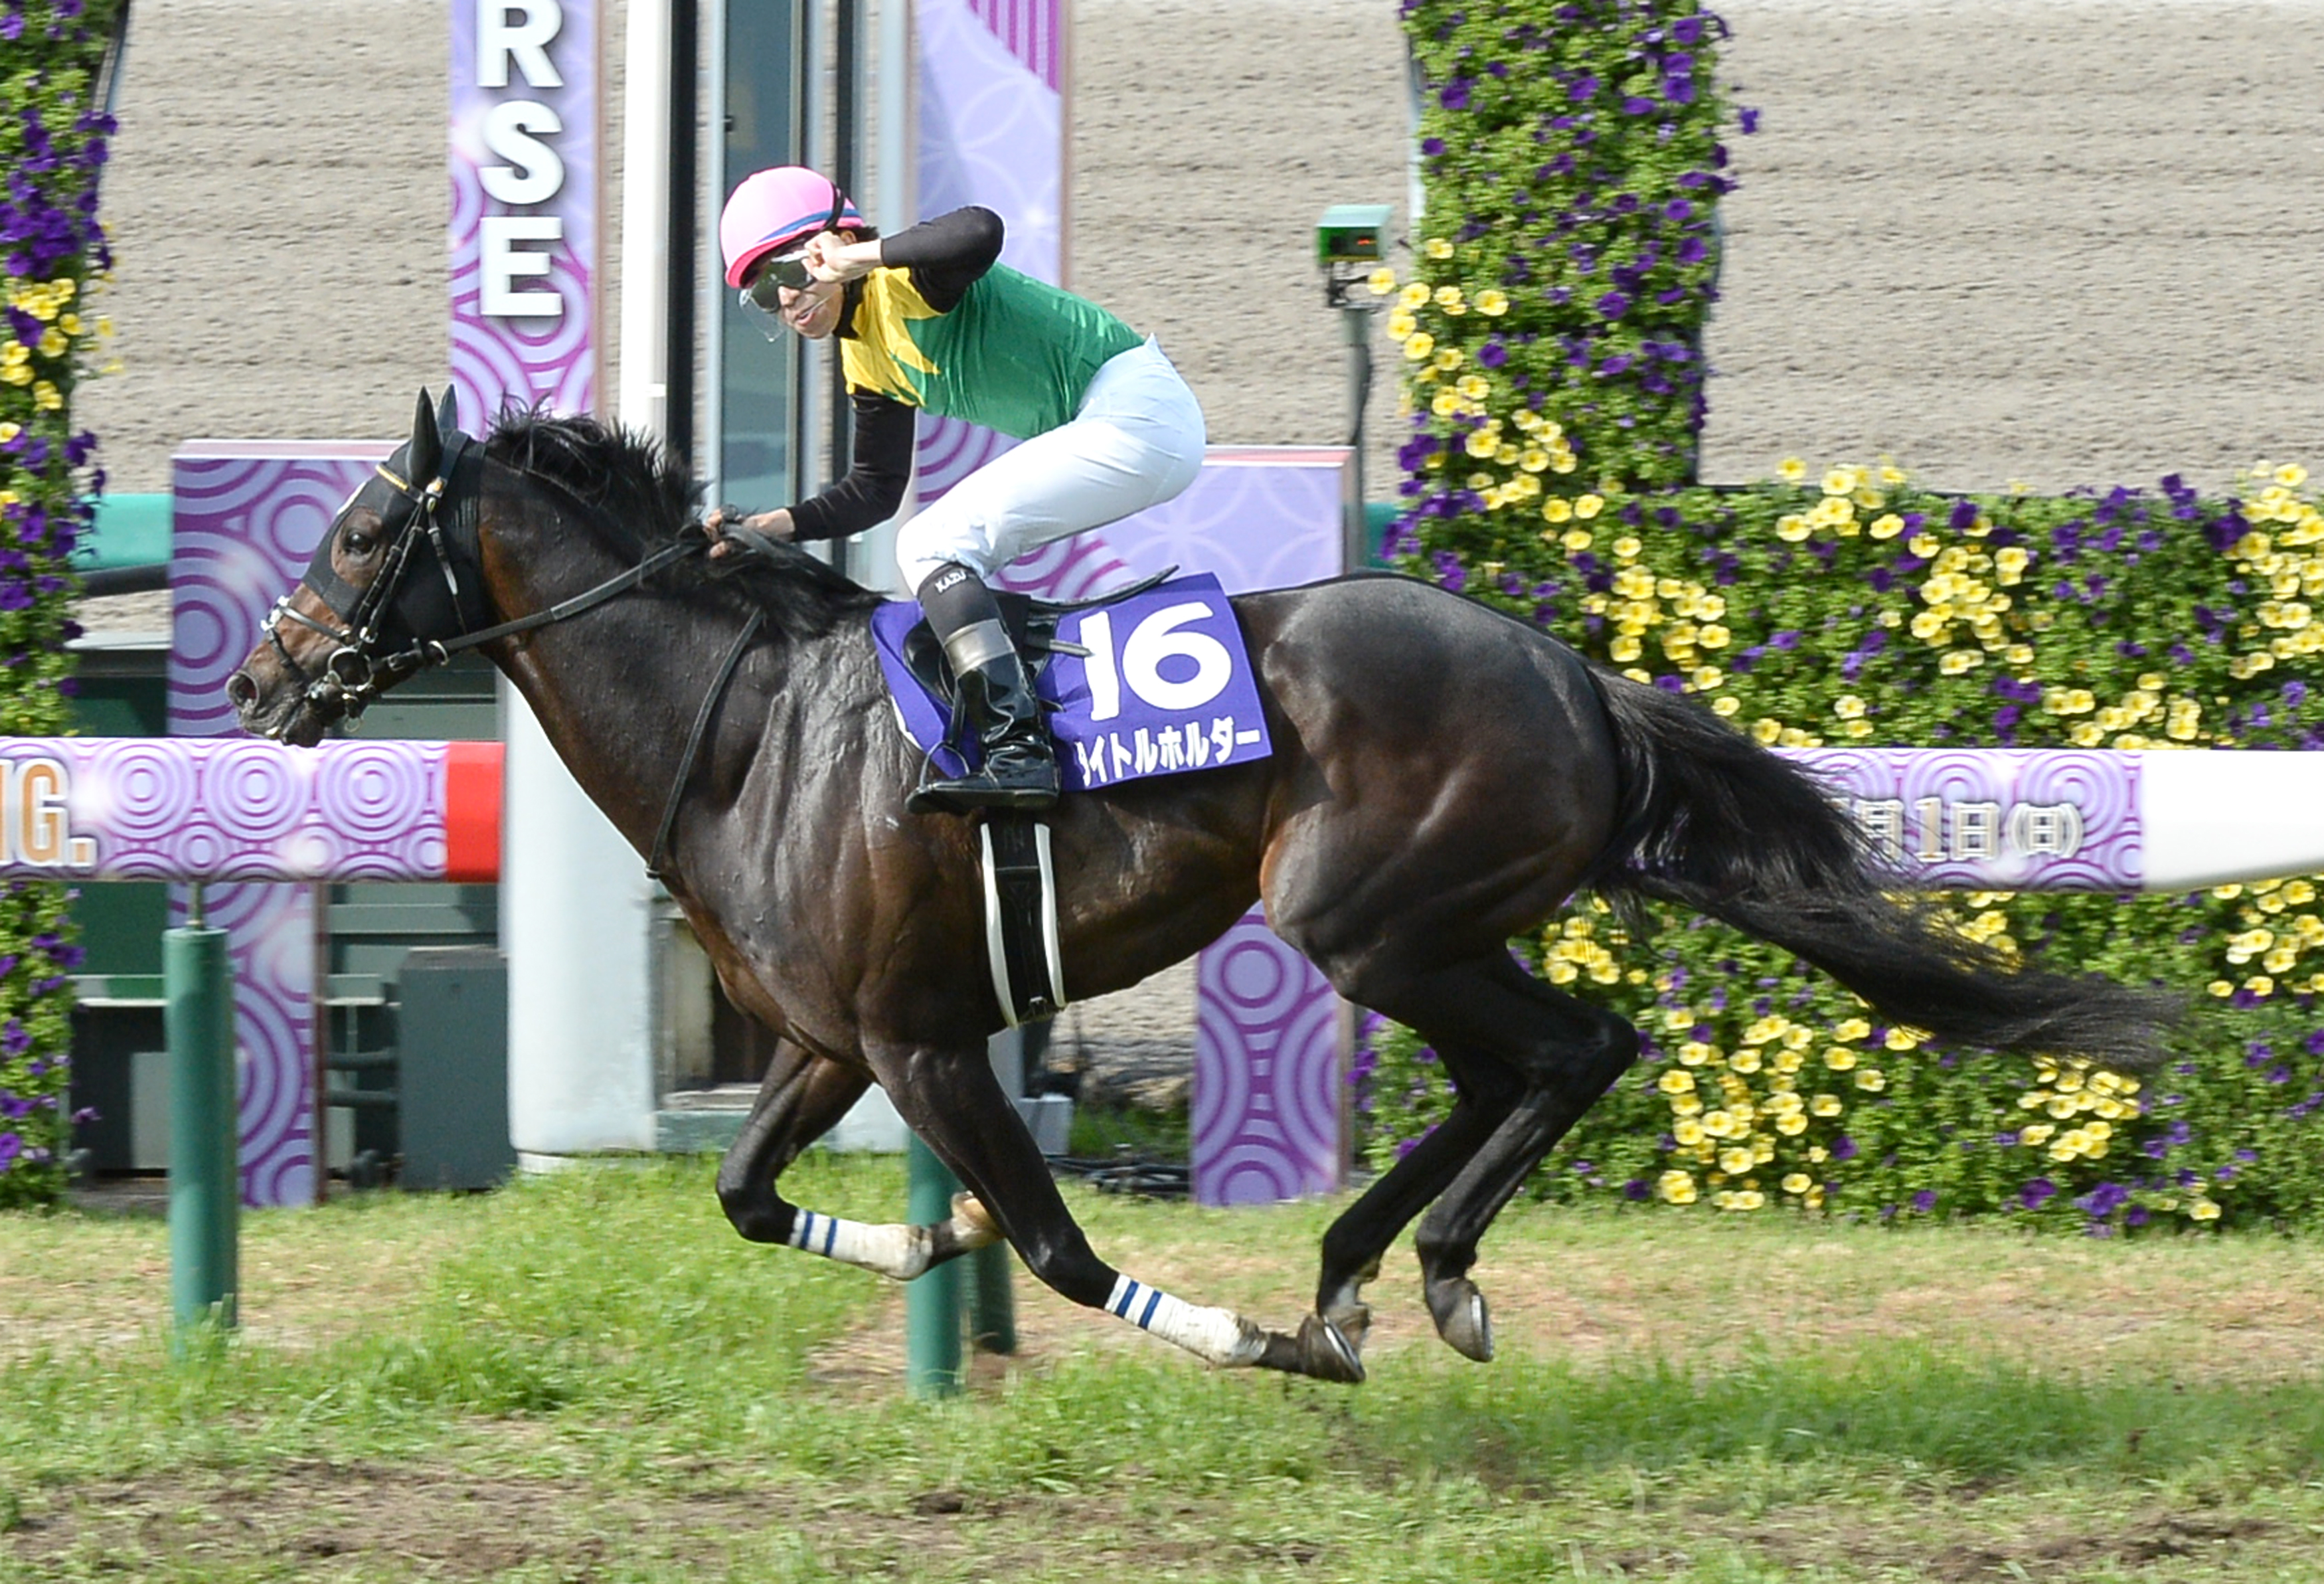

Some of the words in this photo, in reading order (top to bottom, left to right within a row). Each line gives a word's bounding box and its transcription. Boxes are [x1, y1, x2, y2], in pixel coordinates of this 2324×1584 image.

[476, 0, 564, 316] RSE
[1080, 602, 1232, 721] 16
[1823, 797, 2085, 862] 月1日(日)
